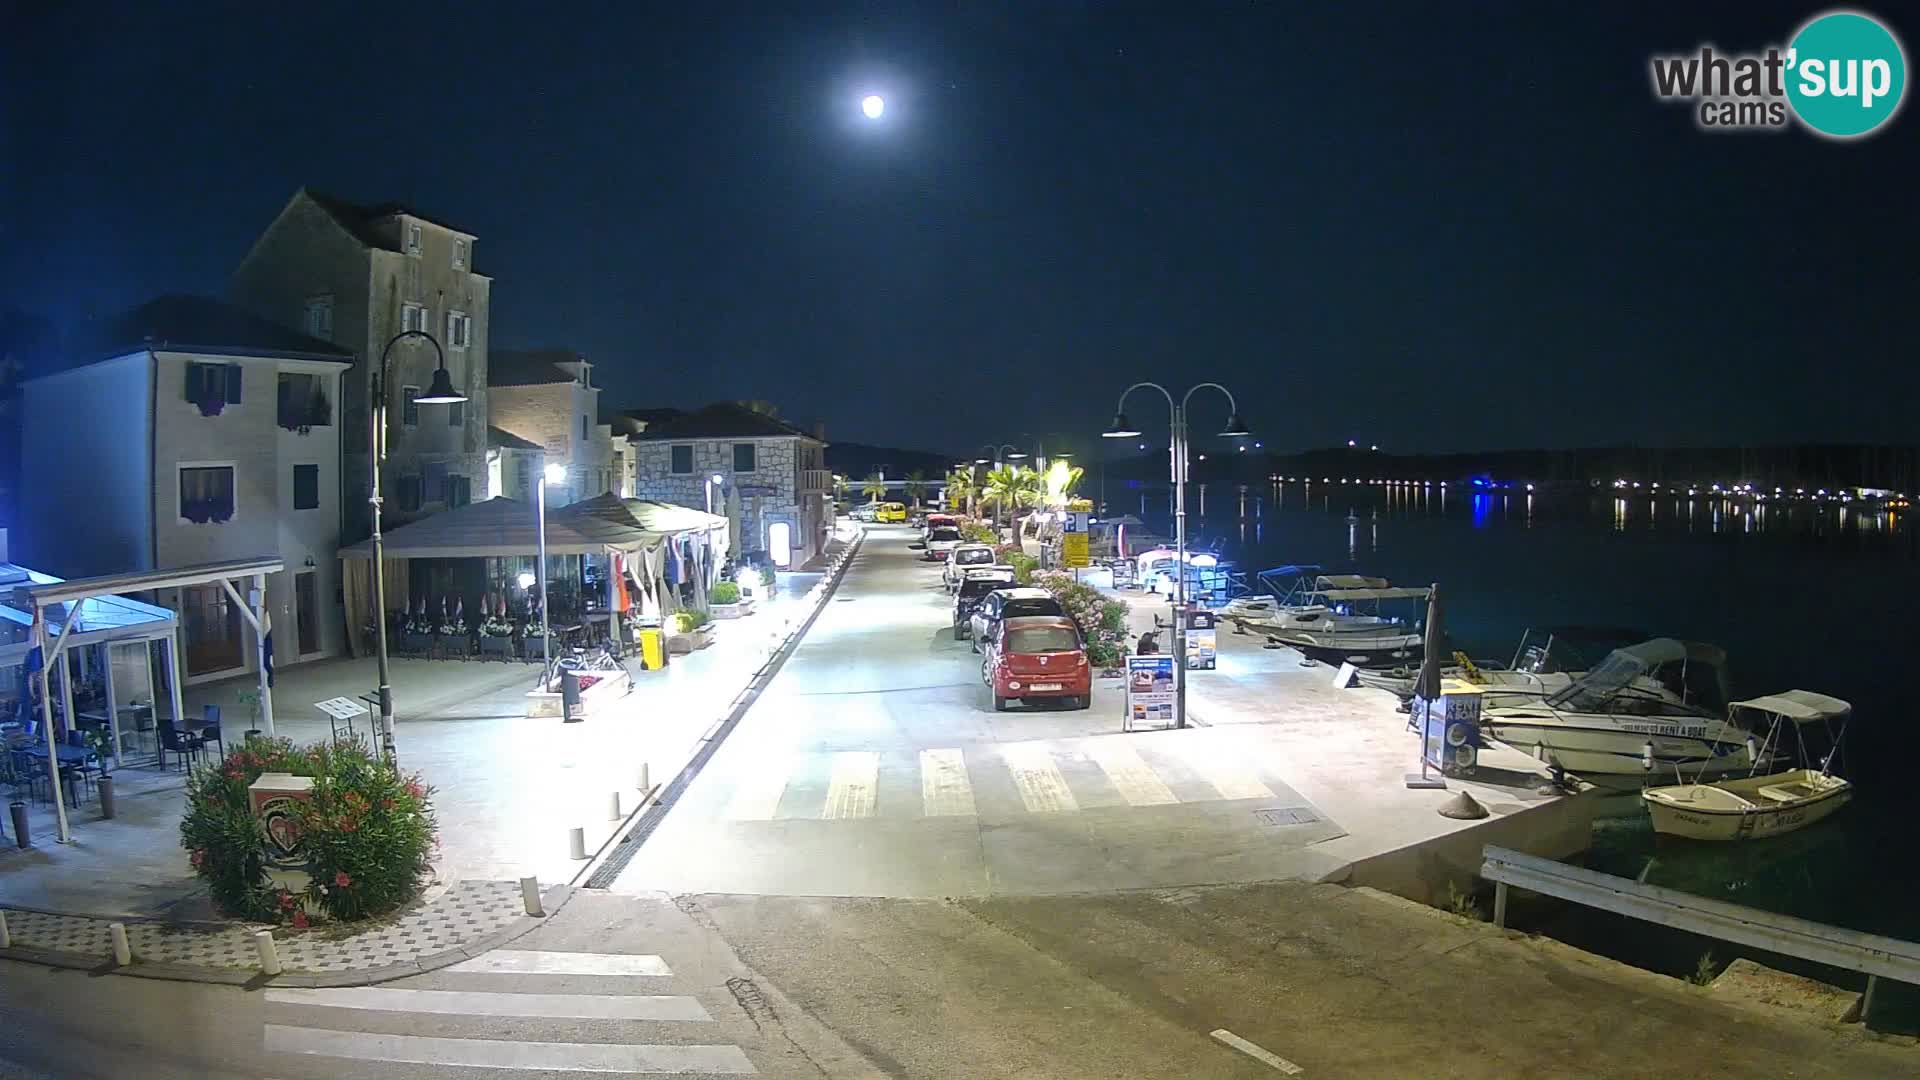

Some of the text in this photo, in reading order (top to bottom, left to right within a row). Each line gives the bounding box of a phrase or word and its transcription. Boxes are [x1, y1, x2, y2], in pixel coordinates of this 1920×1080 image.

[1447, 703, 1479, 712] RENT
[1456, 711, 1478, 720] BOAT
[1660, 724, 1679, 736] RENT
[1687, 726, 1706, 737] BOAT
